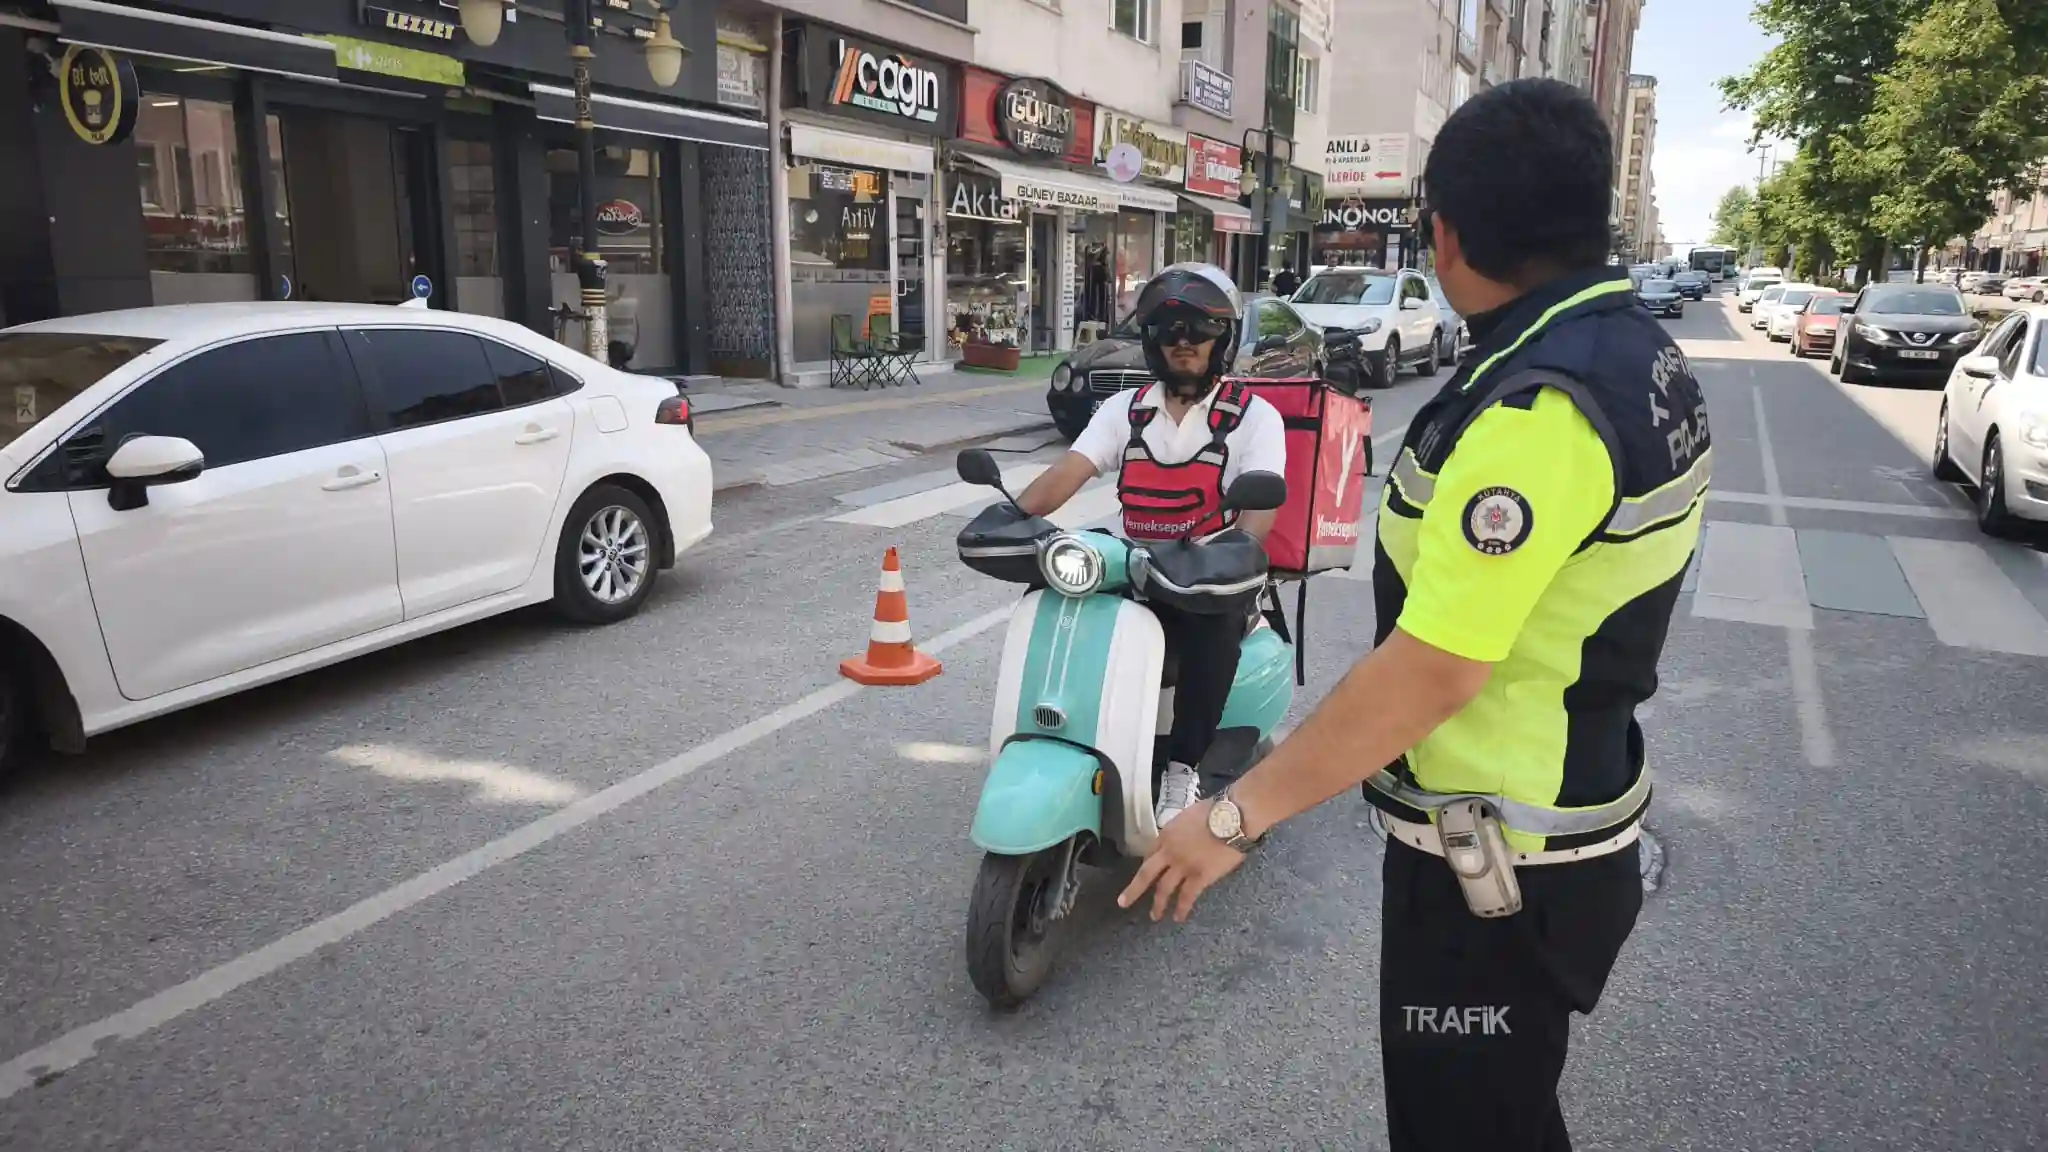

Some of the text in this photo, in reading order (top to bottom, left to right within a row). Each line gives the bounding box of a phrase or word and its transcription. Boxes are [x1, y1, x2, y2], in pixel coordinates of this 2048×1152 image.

[386, 11, 455, 40] LEZZET
[1017, 183, 1098, 207] GÜNEY BAZAAR
[1401, 1005, 1512, 1035] TRAFİK
